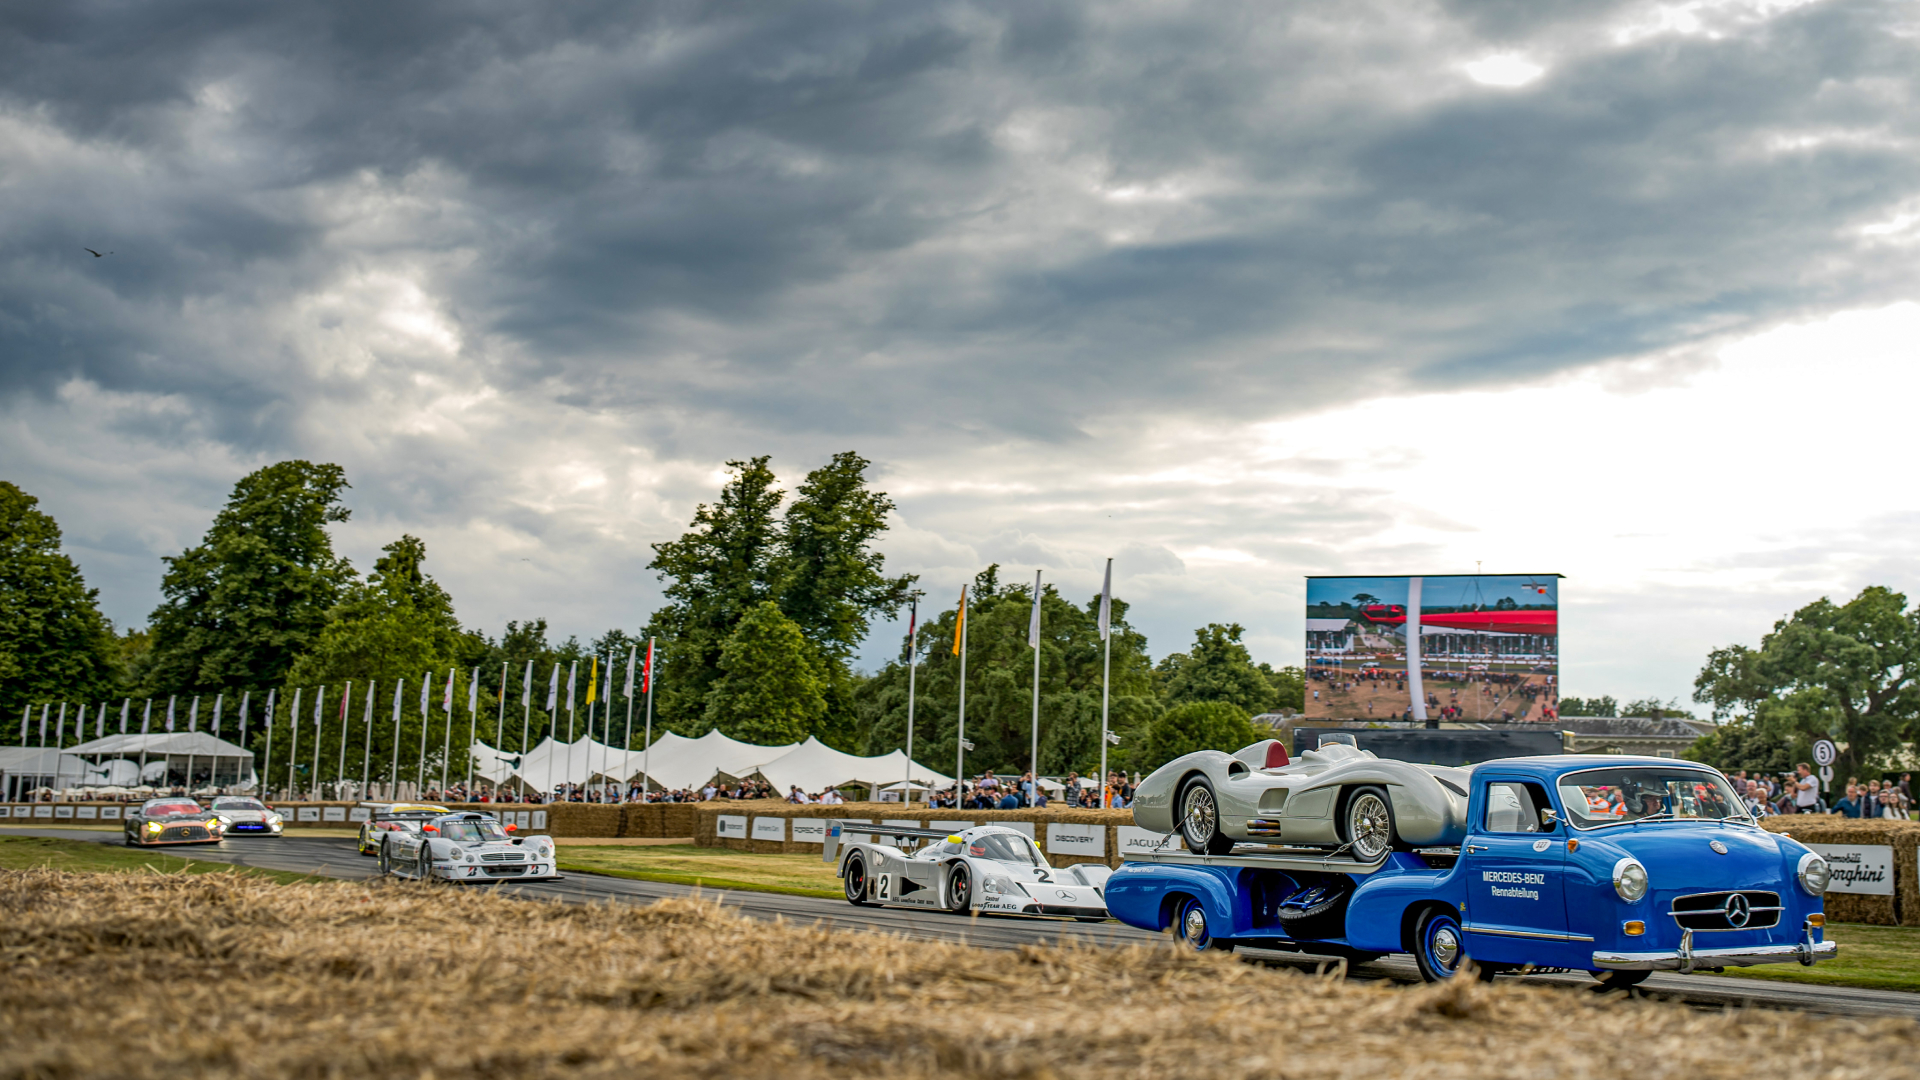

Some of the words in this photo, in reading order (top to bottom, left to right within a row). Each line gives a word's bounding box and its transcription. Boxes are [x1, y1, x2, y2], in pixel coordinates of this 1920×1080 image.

[1820, 746, 1826, 760] 5
[794, 826, 824, 834] PORSCHE
[1055, 834, 1094, 843] DISCOVERY
[1126, 838, 1170, 849] JAGUAR
[1535, 841, 1549, 849] 327
[1033, 868, 1055, 884] 2
[1482, 870, 1546, 885] MERCEDES-BENZ
[880, 874, 889, 899] 2
[1491, 885, 1540, 901] Rennabteilung
